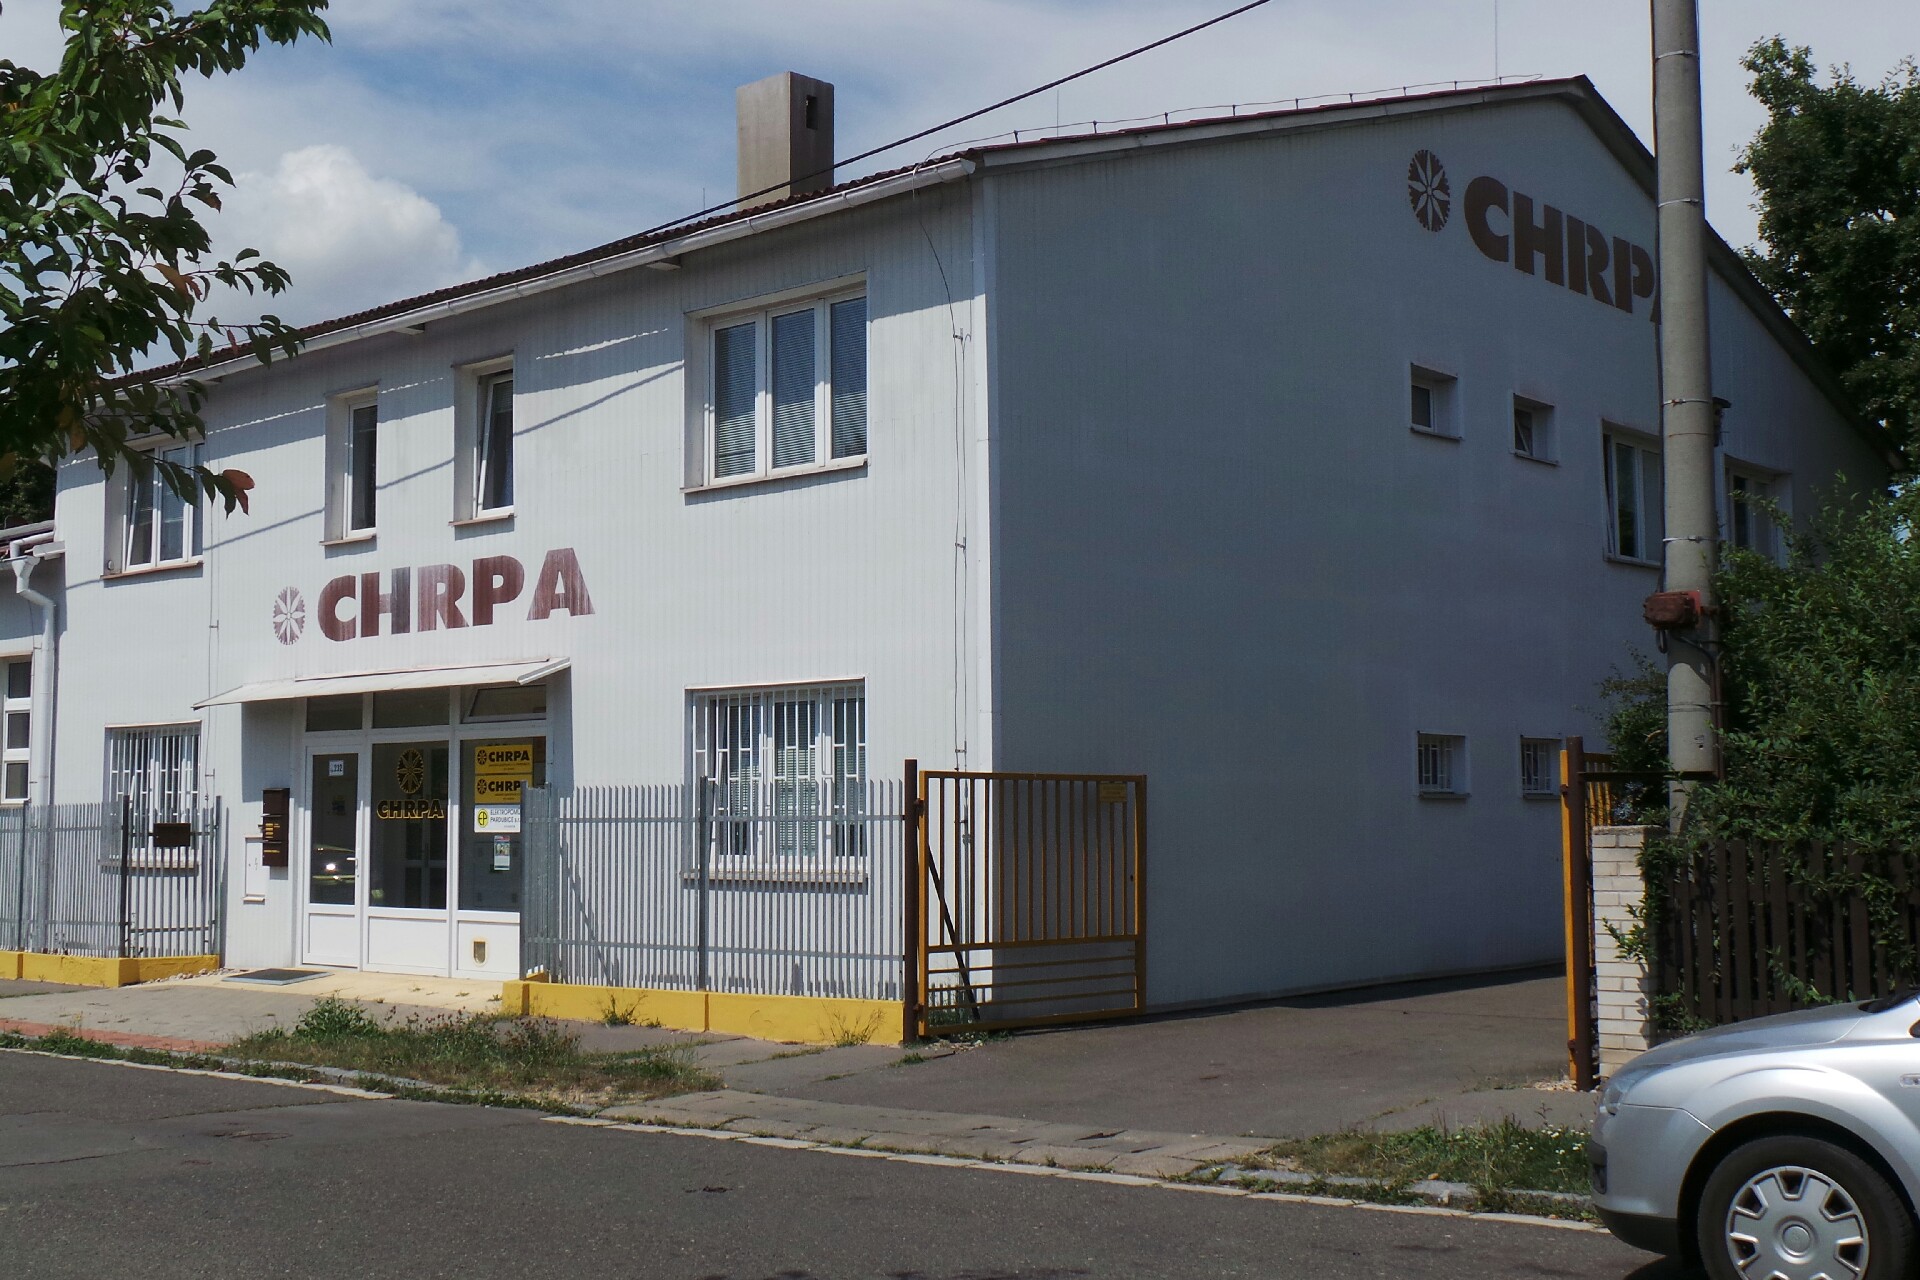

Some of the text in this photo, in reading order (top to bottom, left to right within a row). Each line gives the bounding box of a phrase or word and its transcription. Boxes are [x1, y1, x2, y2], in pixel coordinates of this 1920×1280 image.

[1464, 176, 1661, 325] CHRP
[318, 548, 595, 641] CHRPA
[489, 750, 530, 762] CHRPA
[488, 781, 520, 792] CHRP
[377, 799, 445, 819] CHRPA
